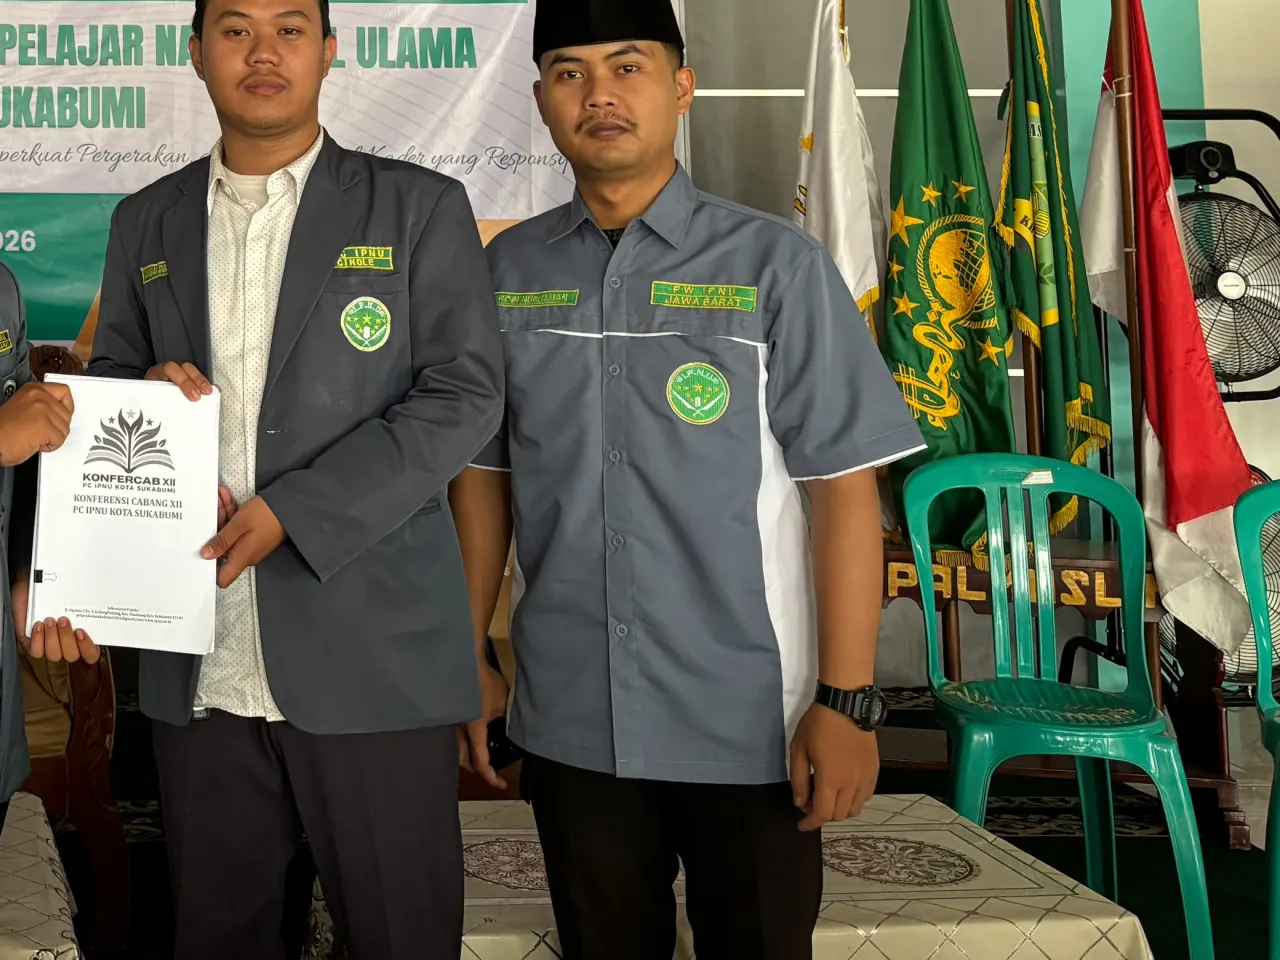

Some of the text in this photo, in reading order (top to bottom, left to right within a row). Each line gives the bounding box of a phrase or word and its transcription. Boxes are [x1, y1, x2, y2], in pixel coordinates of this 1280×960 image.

[356, 26, 478, 69] ULAMA
[431, 152, 480, 174] yang
[354, 248, 385, 258] IPNU
[336, 258, 374, 267] CIKOLE
[665, 296, 742, 307] JAWA BARAT
[82, 473, 176, 486] KONFERCAB XII
[73, 494, 182, 508] KONFERENSI CABANG XII
[72, 505, 182, 520] PC IPNU KOTA SUKABUMI
